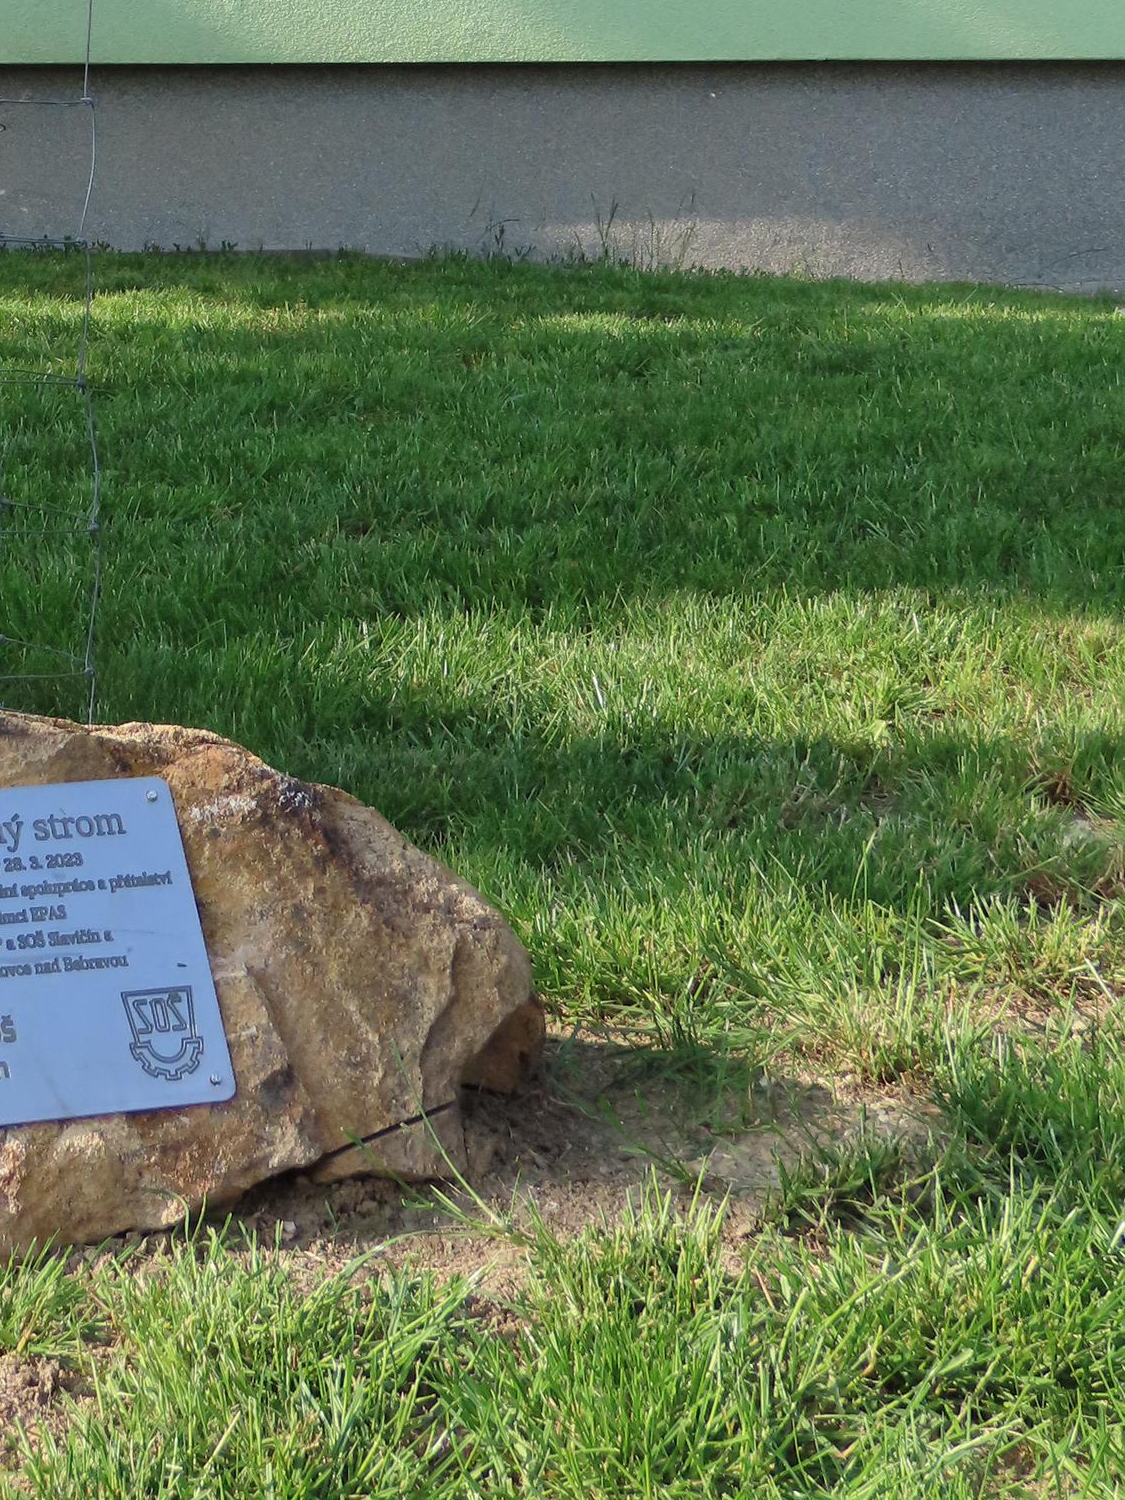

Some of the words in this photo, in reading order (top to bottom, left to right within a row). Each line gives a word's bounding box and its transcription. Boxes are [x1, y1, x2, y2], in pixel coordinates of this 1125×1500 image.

[32, 812, 127, 842] strom
[29, 856, 44, 871] 3.
[46, 851, 84, 869] 2023
[97, 877, 108, 890] a
[29, 904, 68, 922] EPAS
[5, 938, 17, 951] a
[17, 929, 46, 950] SOŠ
[47, 928, 102, 948] Slavičín
[104, 929, 115, 943] a
[33, 956, 62, 976] nad
